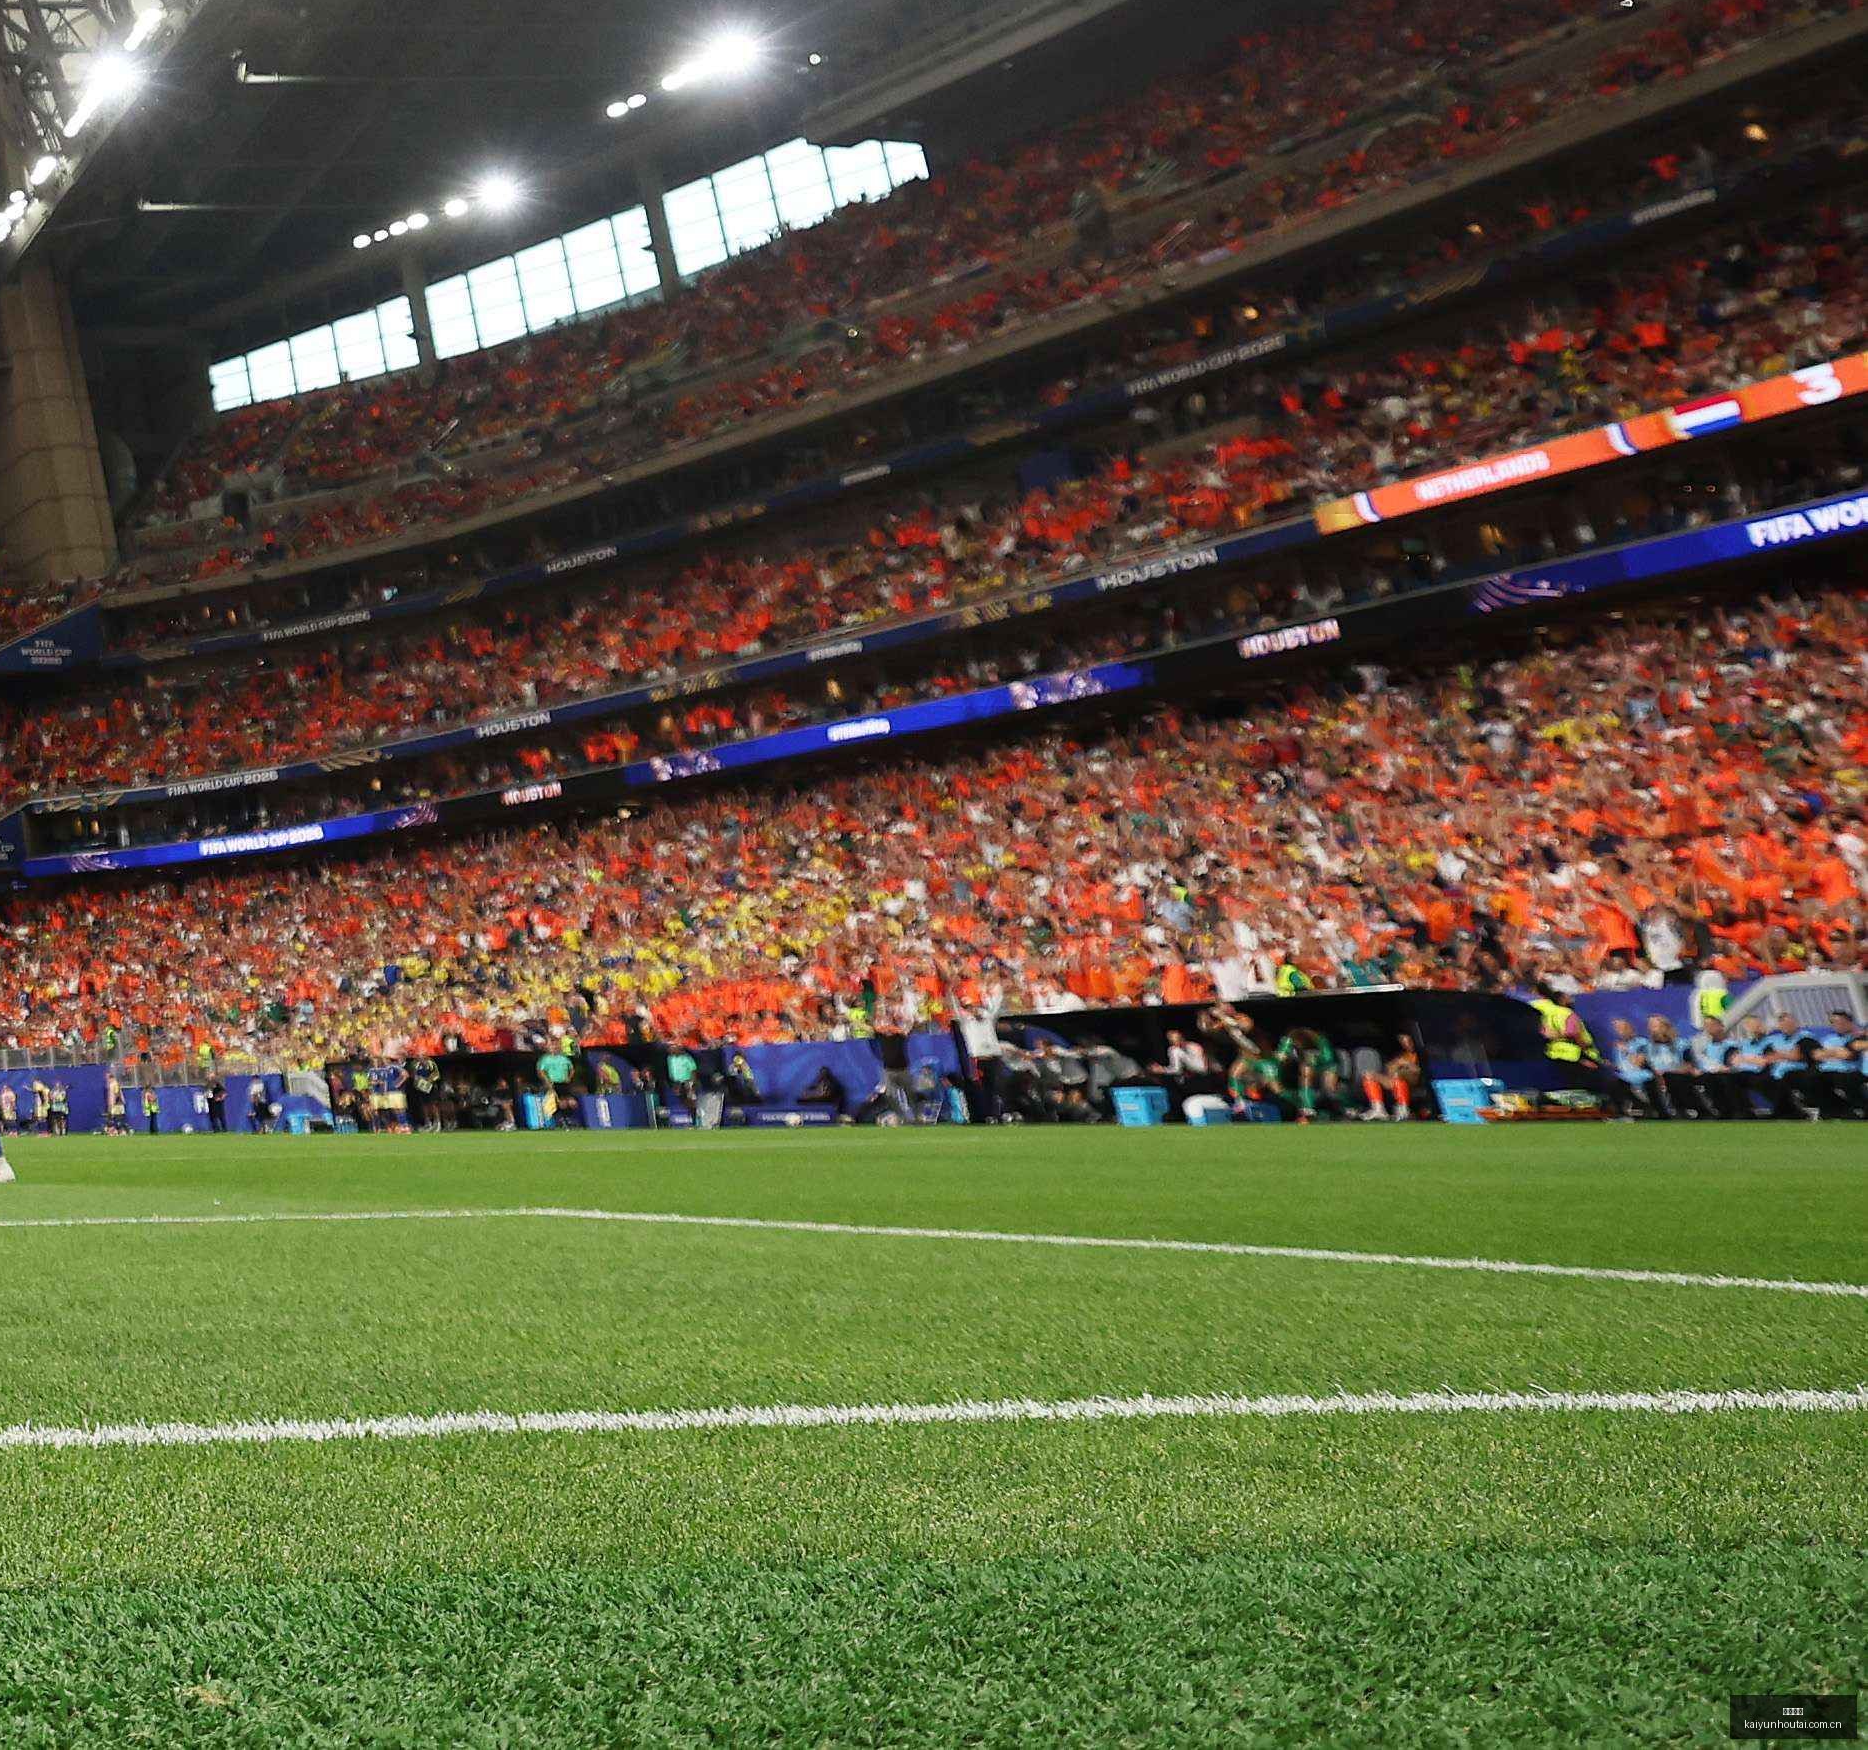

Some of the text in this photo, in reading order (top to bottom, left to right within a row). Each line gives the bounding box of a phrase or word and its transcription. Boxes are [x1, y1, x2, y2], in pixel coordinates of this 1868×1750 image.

[1791, 362, 1843, 405] 3
[1745, 512, 1814, 548] FIFA
[546, 546, 619, 574] HOUSTON
[1095, 547, 1219, 591] HOUSTON
[476, 711, 552, 738] HOUSTON
[167, 770, 279, 797] FIFA WORLD CUP 2026
[200, 838, 227, 856] FIFA
[226, 834, 269, 853] WORLD
[267, 831, 289, 848] CUP
